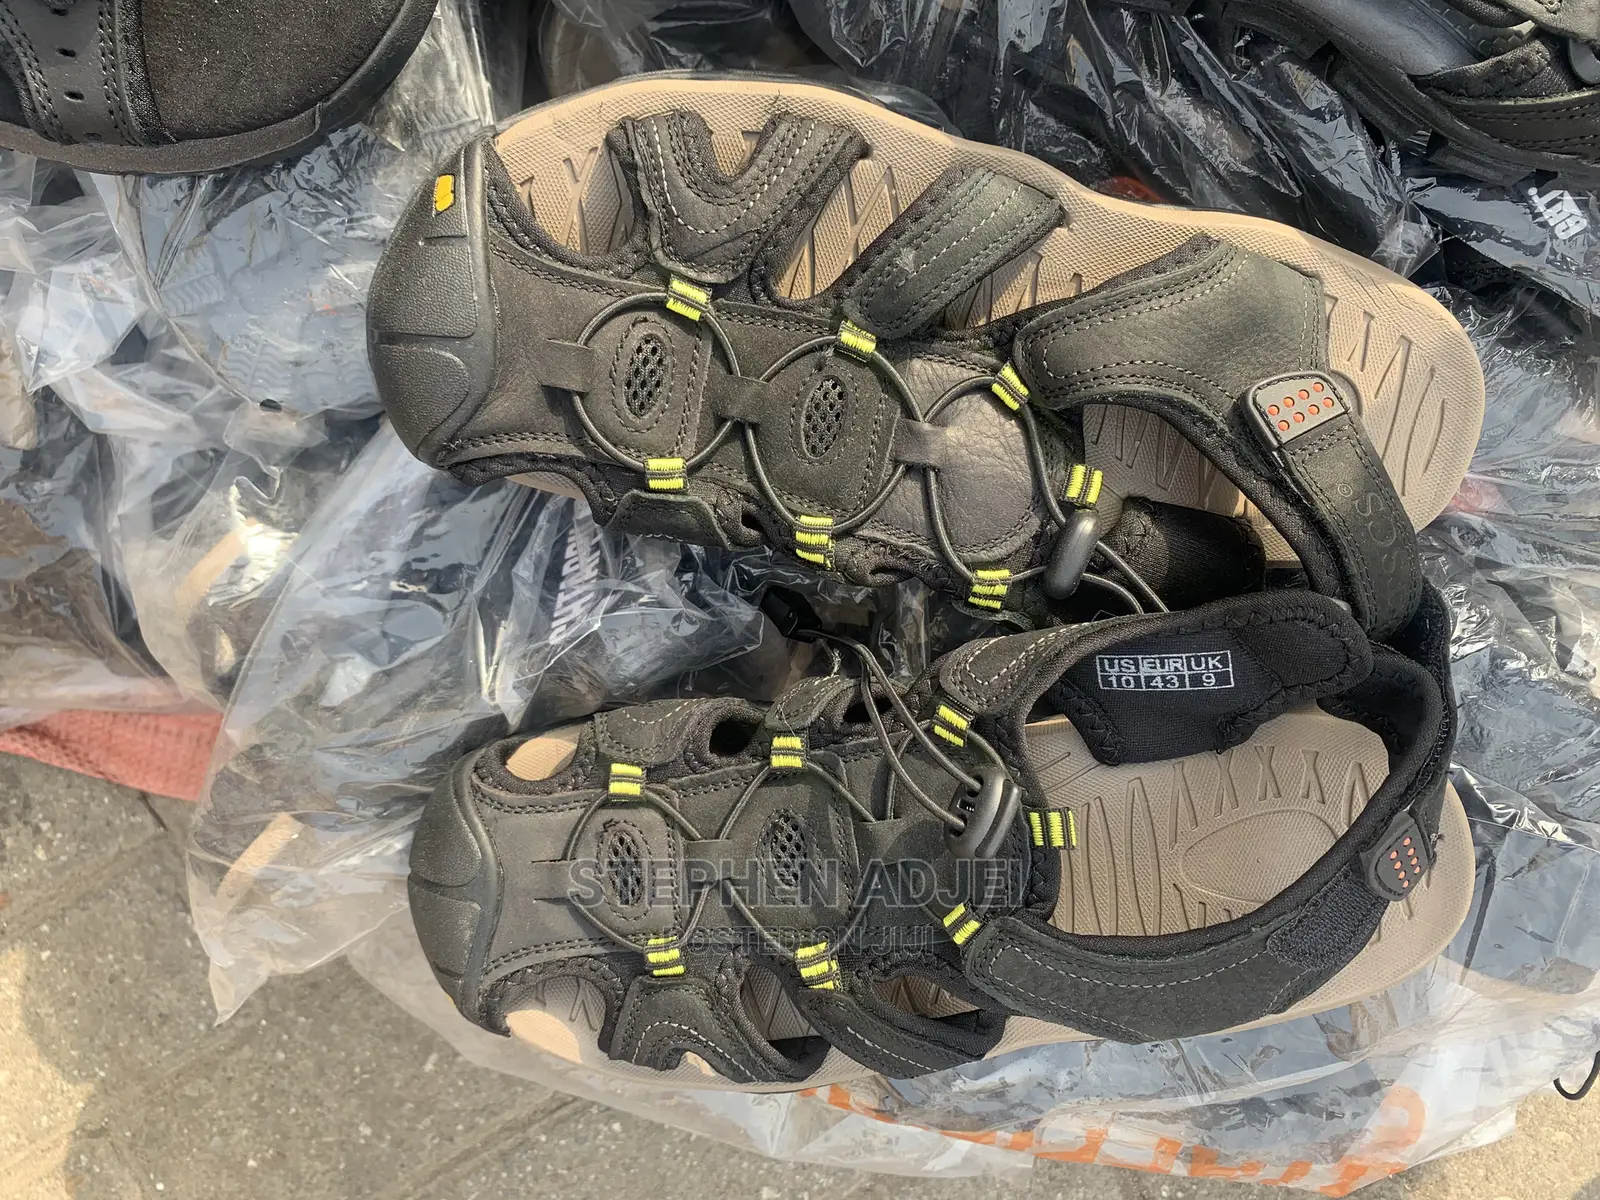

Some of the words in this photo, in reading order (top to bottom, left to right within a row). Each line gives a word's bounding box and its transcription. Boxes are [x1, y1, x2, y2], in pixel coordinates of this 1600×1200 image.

[1103, 658, 1137, 673] US
[1143, 658, 1184, 672] EUR
[1190, 655, 1224, 670] UK
[1107, 675, 1136, 689] 10
[1149, 675, 1180, 689] 43
[1201, 673, 1216, 687] 9
